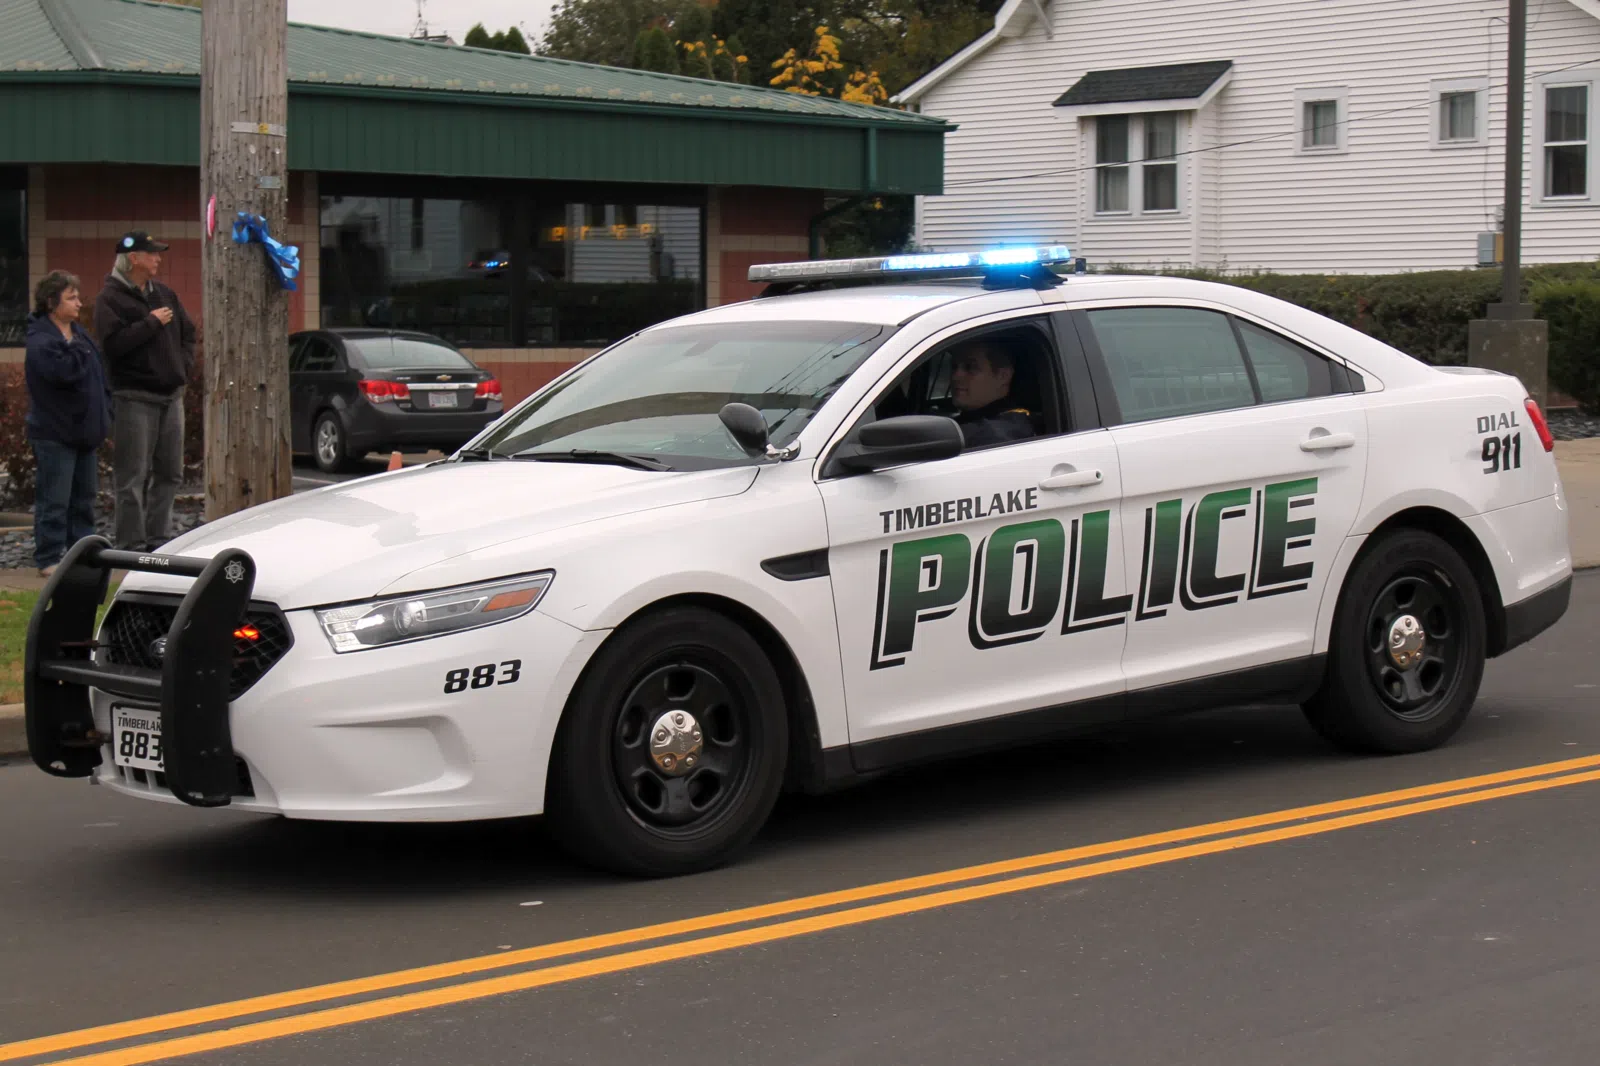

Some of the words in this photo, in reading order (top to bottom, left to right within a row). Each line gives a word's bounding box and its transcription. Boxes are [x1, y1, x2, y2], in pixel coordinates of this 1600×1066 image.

[1477, 411, 1519, 434] DIAL
[1482, 432, 1521, 475] 911
[879, 487, 1037, 534] TIMBERLAKE
[138, 556, 169, 566] SETINA
[870, 477, 1318, 671] POLICE
[444, 659, 522, 694] 883
[118, 717, 161, 732] TIMBERLAK
[120, 730, 162, 761] 883
